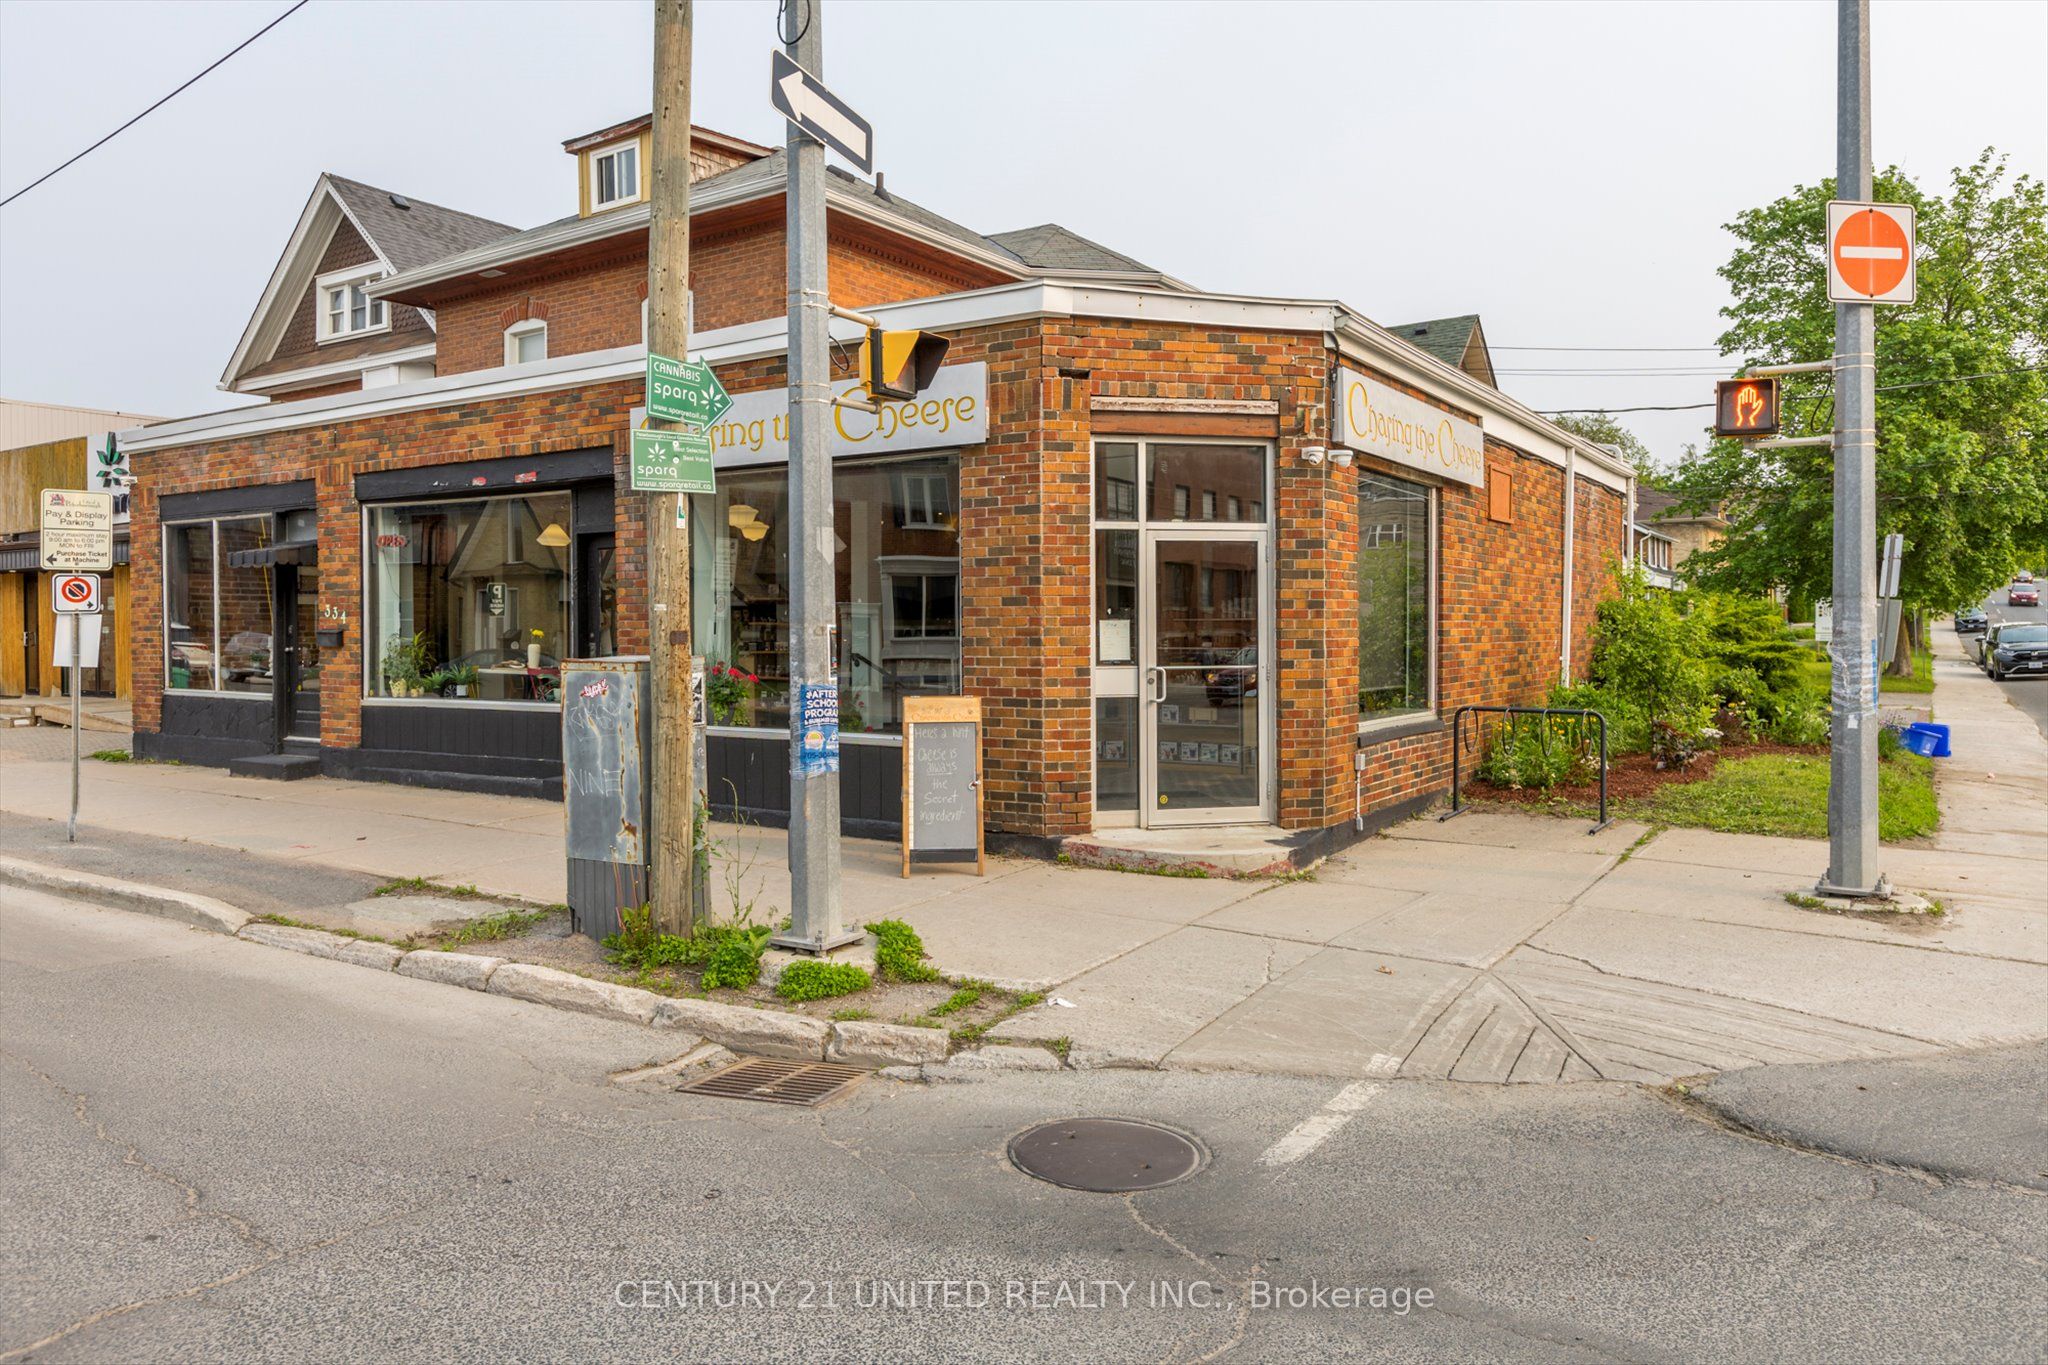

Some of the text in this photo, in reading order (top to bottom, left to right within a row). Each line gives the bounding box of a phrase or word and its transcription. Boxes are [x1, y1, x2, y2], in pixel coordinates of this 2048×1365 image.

[653, 361, 701, 382] CANNABIS
[653, 382, 697, 406] sparq
[833, 386, 977, 443] Cheese
[1347, 381, 1482, 476] Chasing the Cheese
[637, 464, 678, 479] sparq
[45, 509, 63, 519] Pay
[75, 511, 108, 520] Display
[60, 518, 95, 528] Parking
[324, 604, 346, 625] 334
[805, 699, 839, 710] SCHOO
[952, 725, 971, 739] hint
[950, 746, 958, 759] is
[926, 759, 958, 773] always
[569, 767, 622, 797] NINE
[931, 776, 949, 791] the
[923, 789, 959, 806] Secret
[919, 804, 966, 825] ingredient
